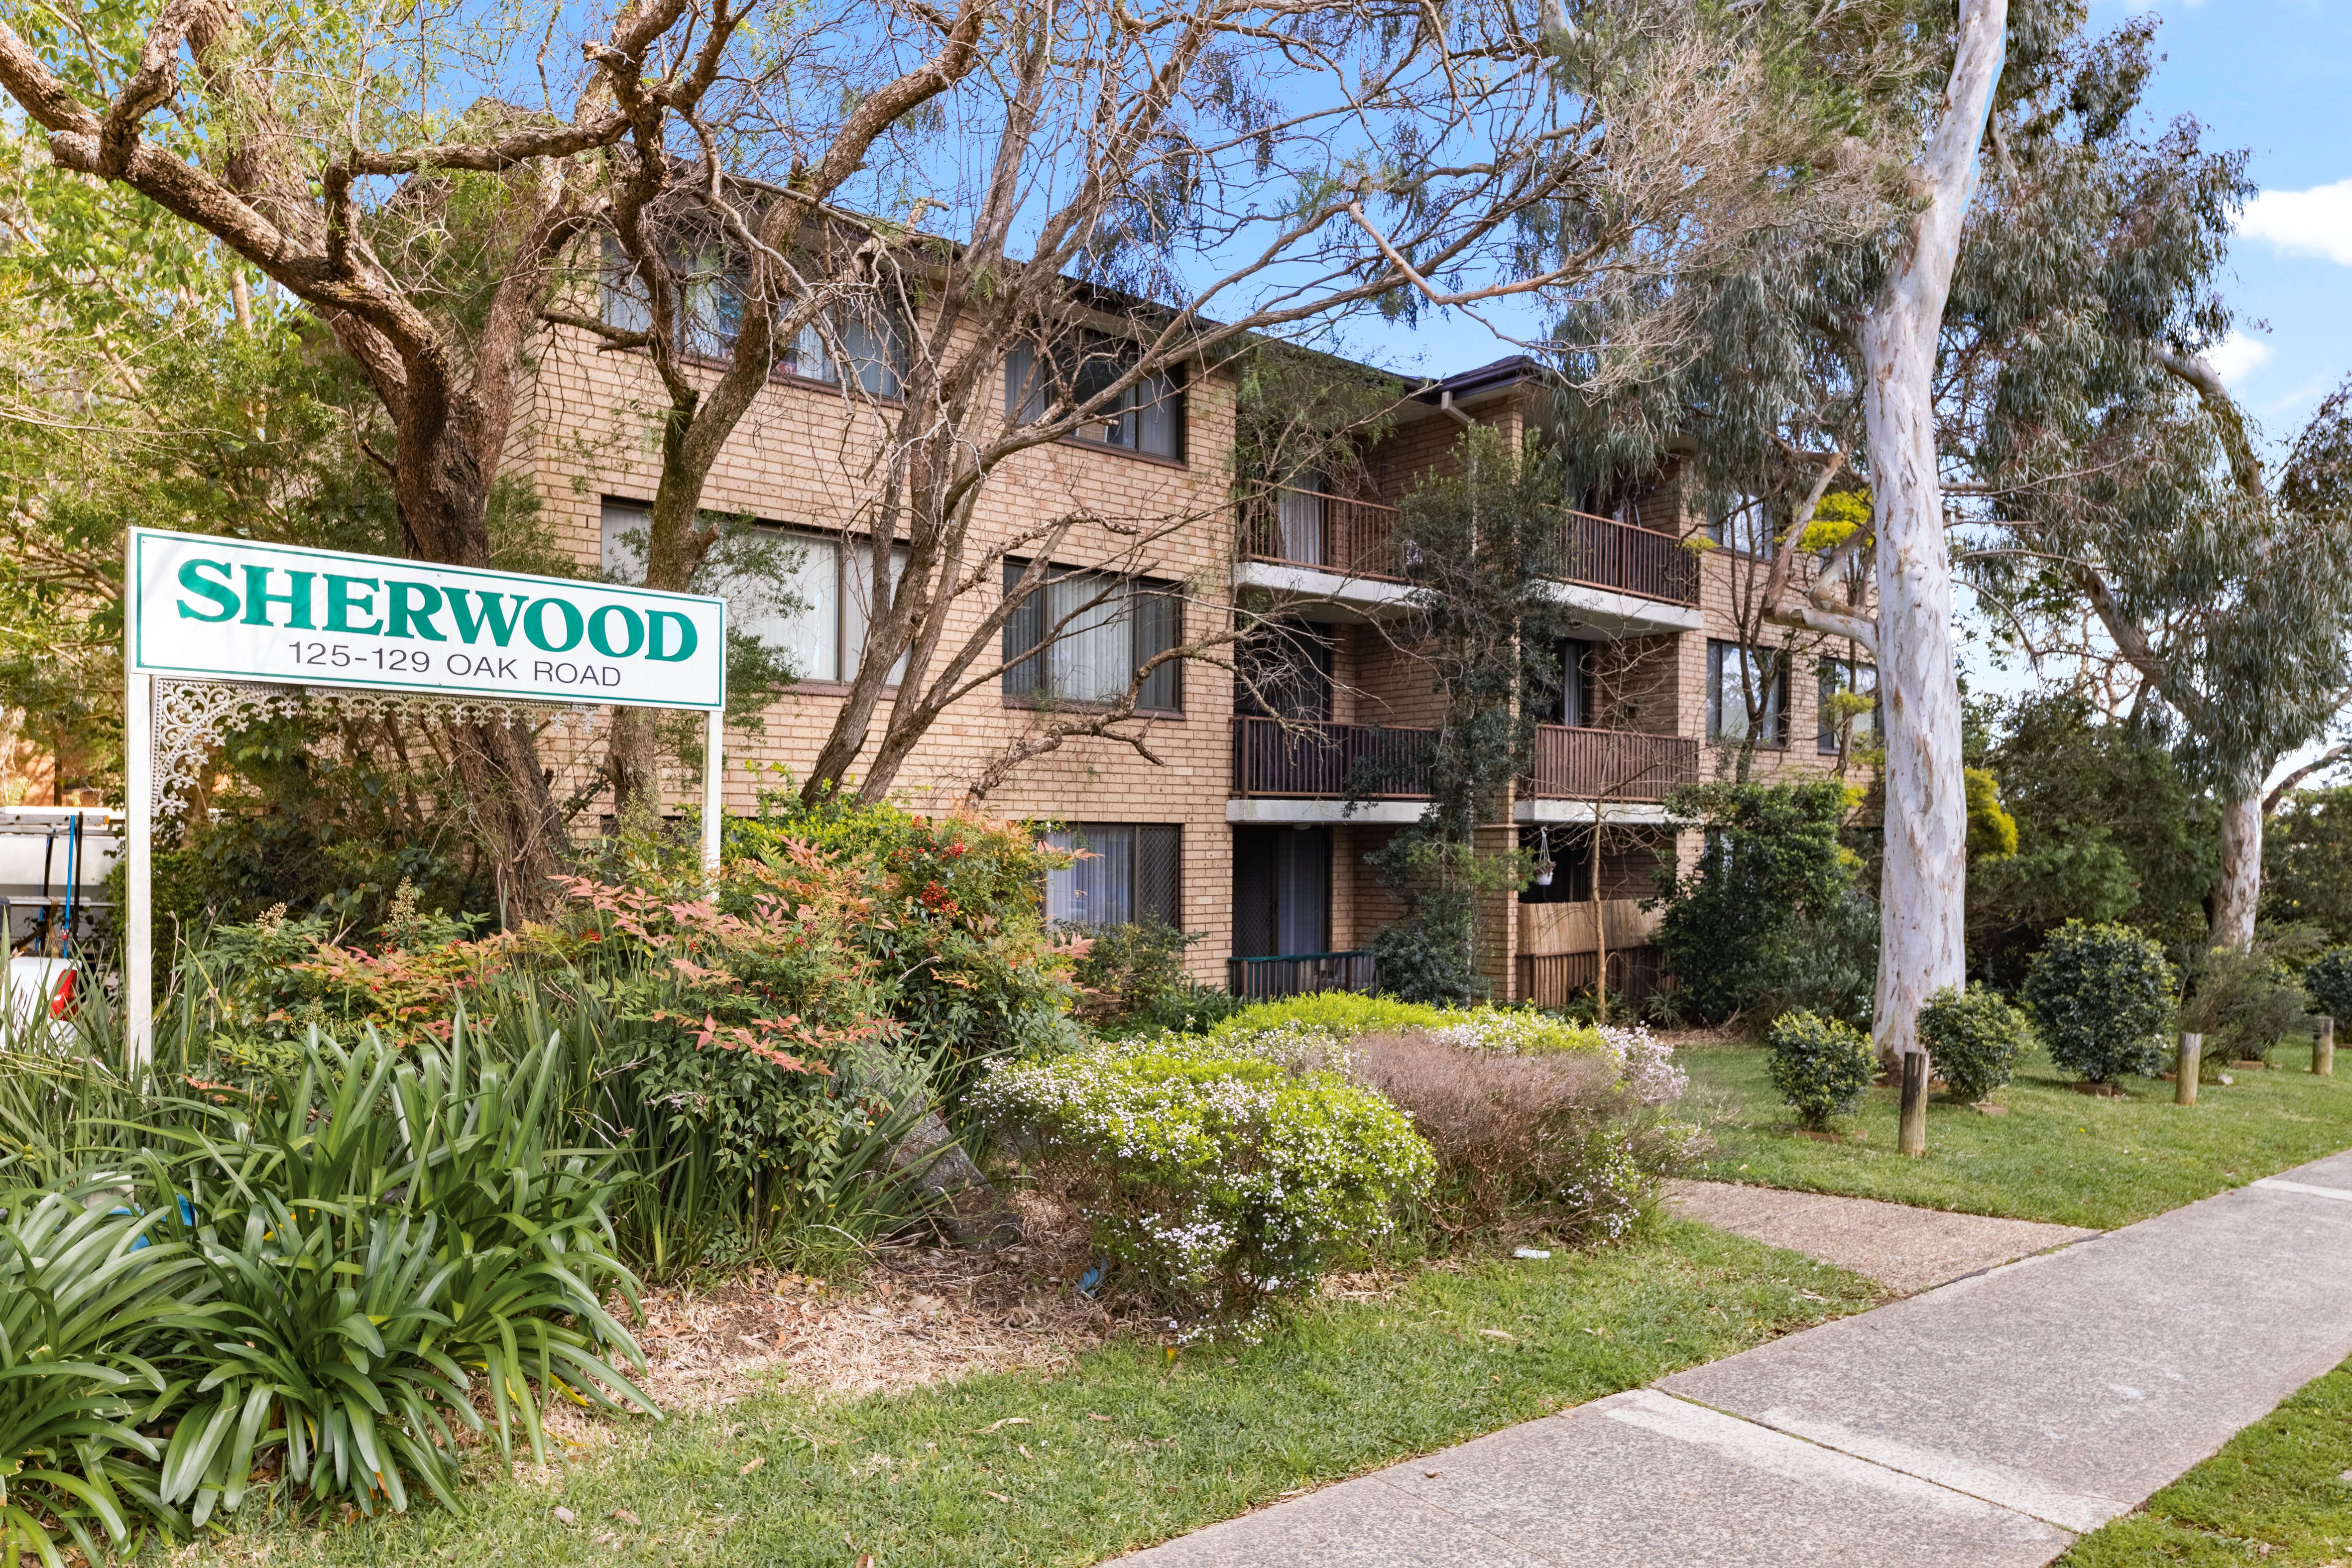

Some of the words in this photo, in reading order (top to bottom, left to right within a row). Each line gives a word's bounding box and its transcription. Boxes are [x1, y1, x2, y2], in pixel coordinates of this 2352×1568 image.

[176, 558, 698, 662] SHERWOOD
[288, 641, 430, 673] 125-129
[447, 654, 518, 679] OAK
[534, 661, 621, 687] ROAD
